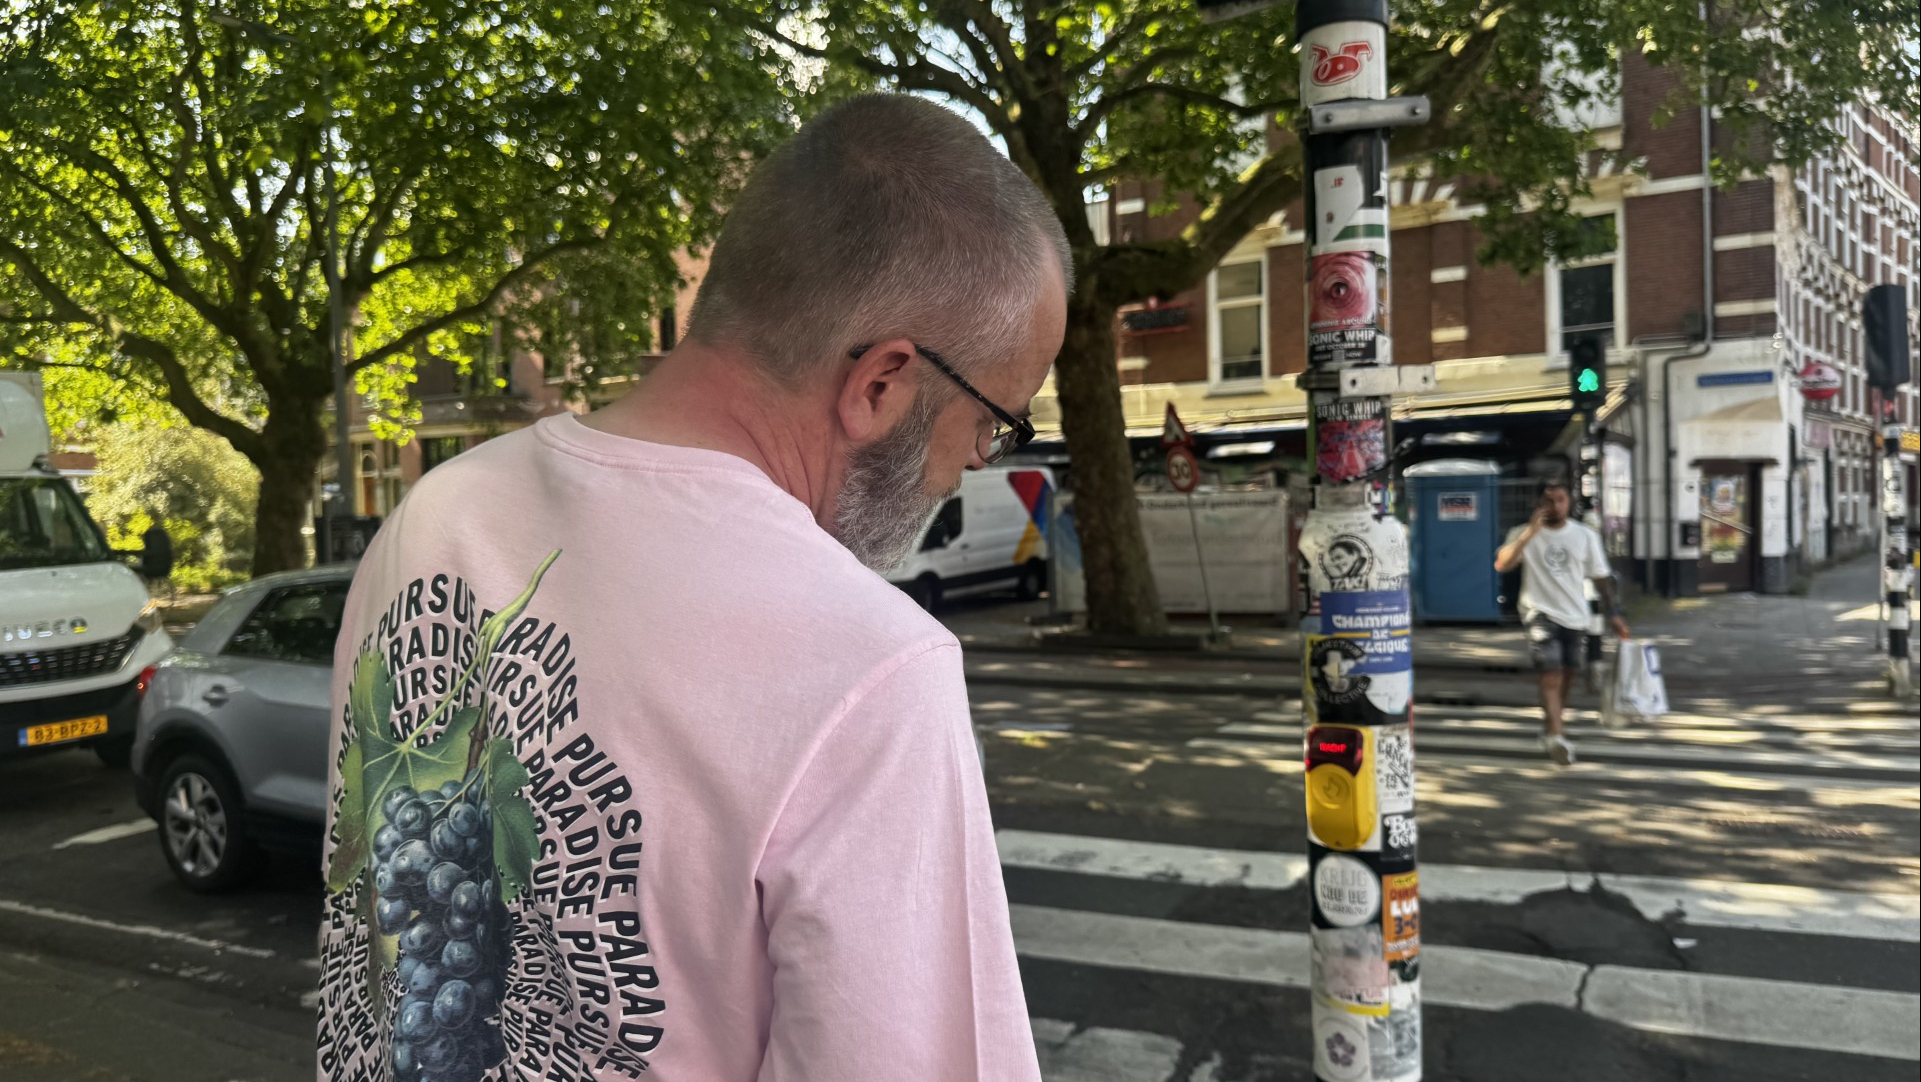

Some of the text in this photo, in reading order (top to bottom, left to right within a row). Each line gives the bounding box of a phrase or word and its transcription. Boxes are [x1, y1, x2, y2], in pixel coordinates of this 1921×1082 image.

[1316, 400, 1381, 418] SONIC WHIP
[1344, 330, 1375, 342] WHIP
[522, 748, 603, 920] PARADISE
[551, 732, 643, 901] PURSUE
[557, 930, 611, 1056] PURSUE
[595, 910, 666, 1080] PARADISE
